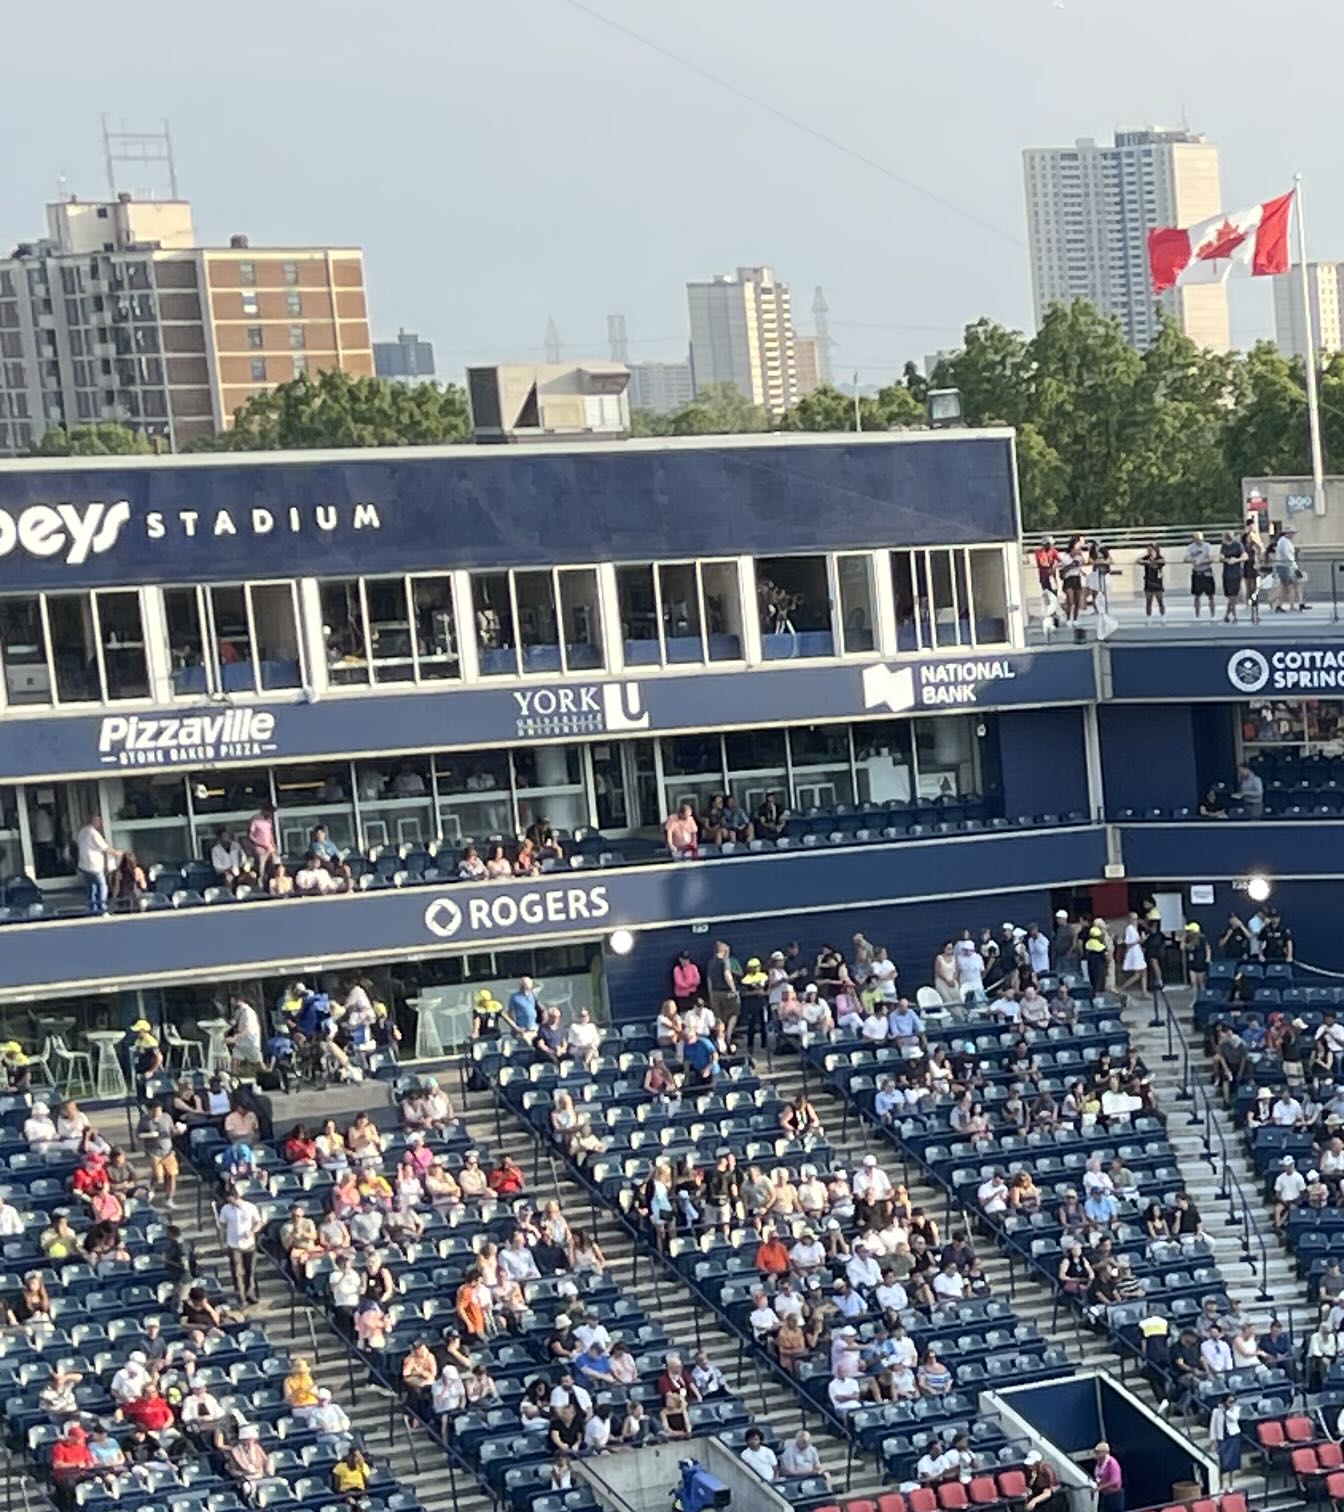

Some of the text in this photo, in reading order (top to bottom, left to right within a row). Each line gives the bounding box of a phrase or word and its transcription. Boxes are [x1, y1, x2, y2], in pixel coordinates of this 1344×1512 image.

[147, 503, 380, 539] STADIUM
[920, 660, 1015, 684] NATIONAL
[513, 687, 600, 715] YORK
[922, 682, 977, 705] BANK
[99, 708, 275, 752] Pizzaville
[119, 743, 261, 765] STONE BAKED PIZZA
[470, 887, 609, 930] ROGERS
